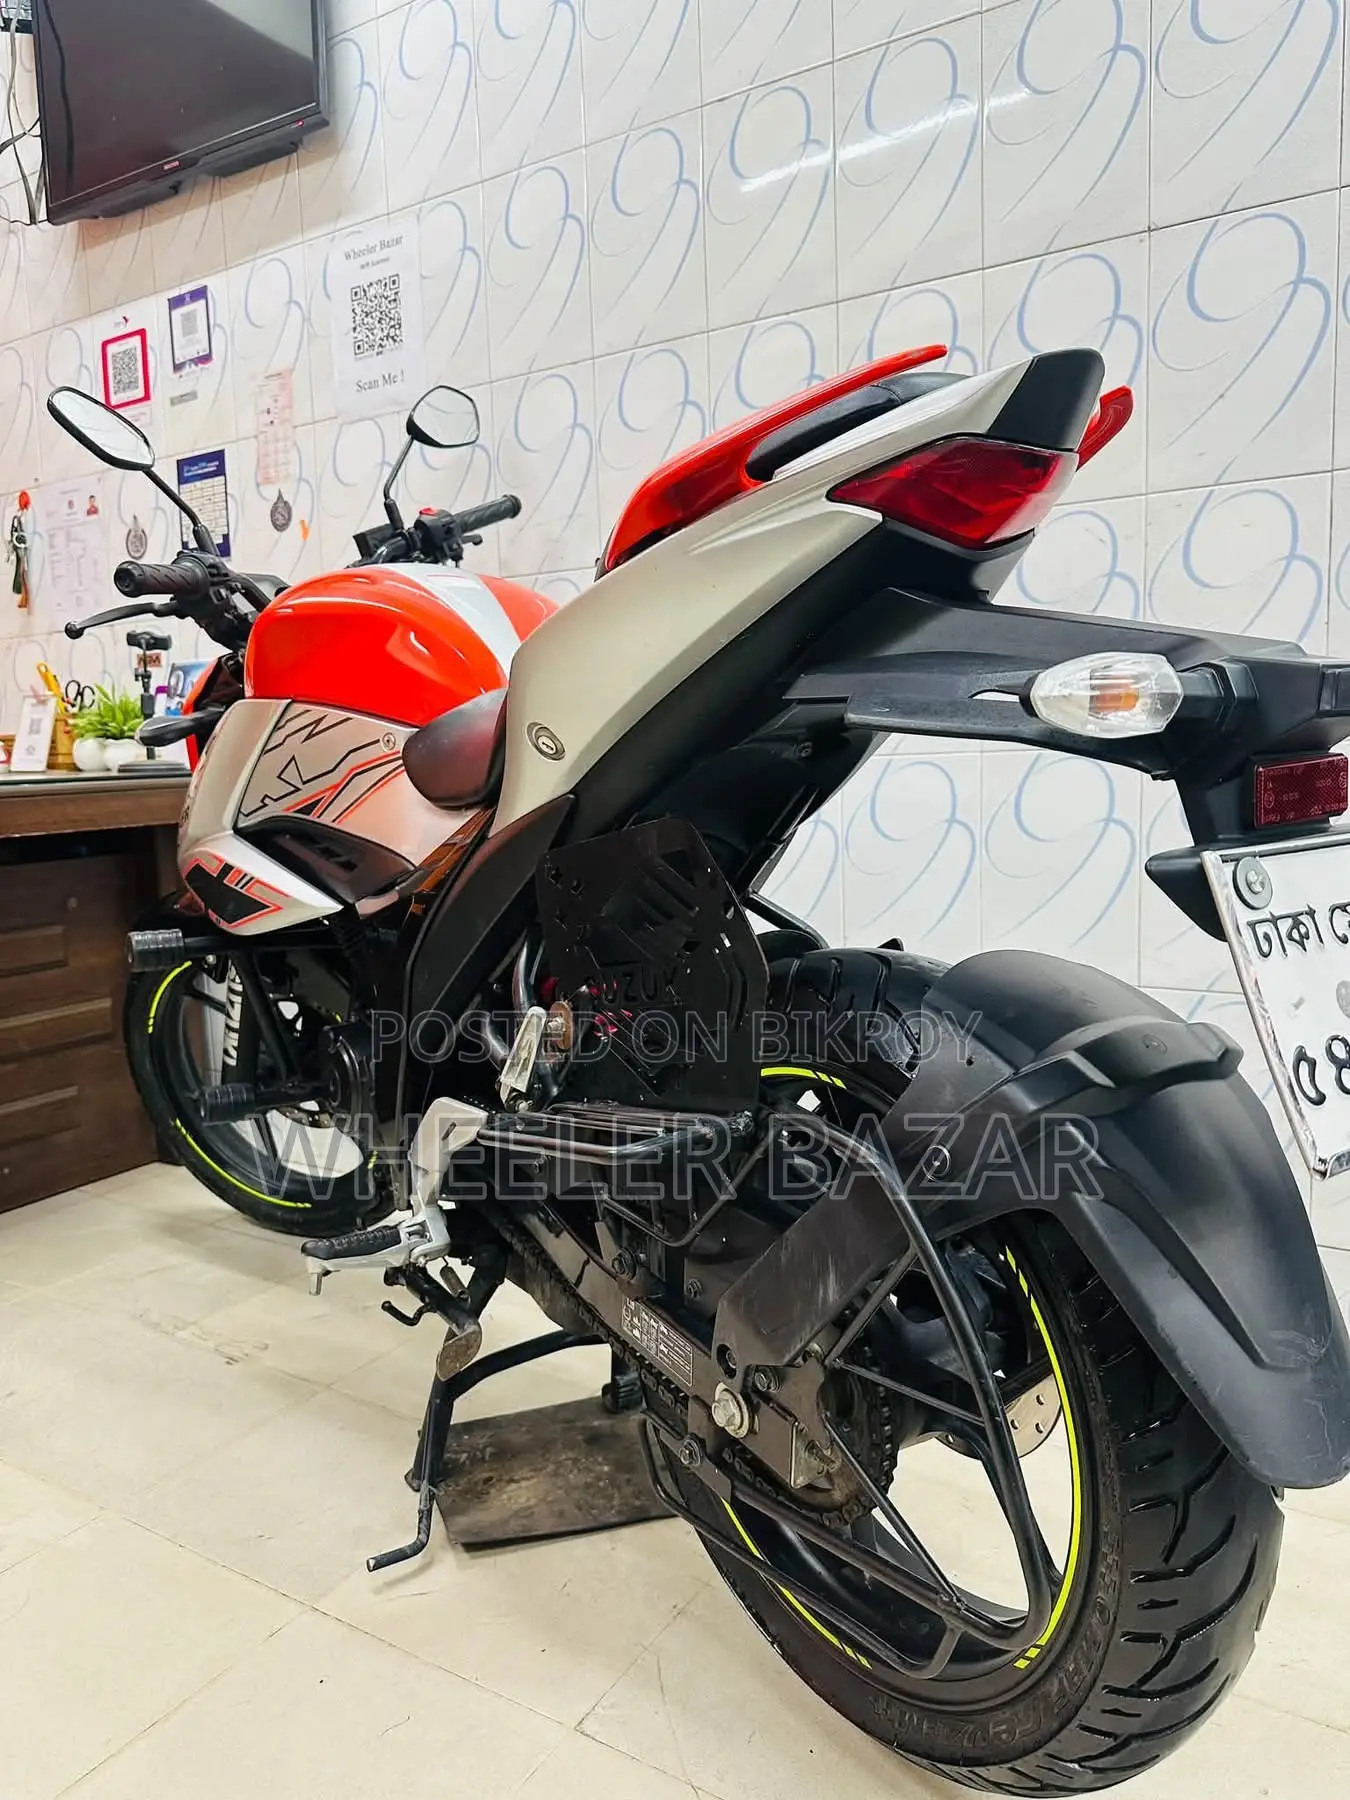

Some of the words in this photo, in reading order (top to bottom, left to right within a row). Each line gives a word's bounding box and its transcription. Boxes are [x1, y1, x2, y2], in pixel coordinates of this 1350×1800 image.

[344, 243, 377, 261] Wheeler
[379, 235, 403, 251] Bazar
[356, 379, 380, 393] Scan
[382, 372, 398, 387] Me
[1246, 903, 1325, 959] ঢাকা
